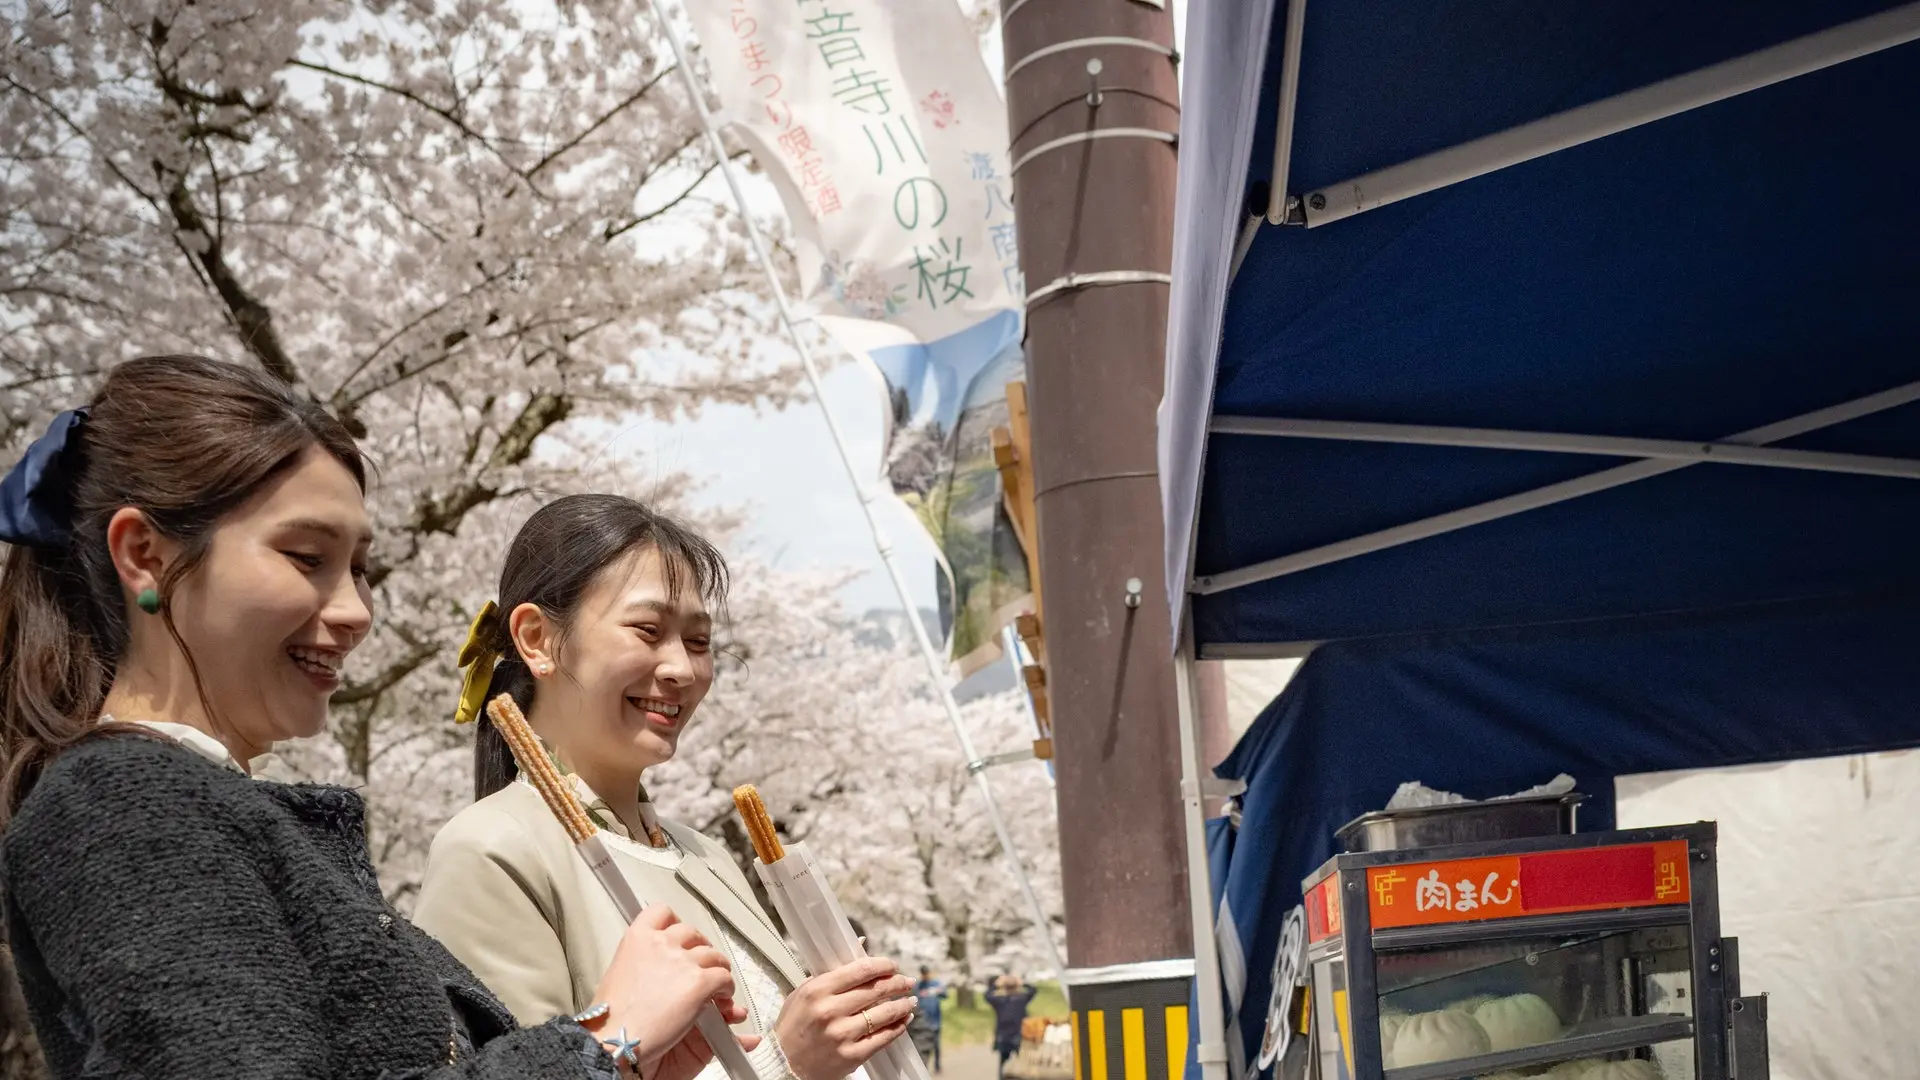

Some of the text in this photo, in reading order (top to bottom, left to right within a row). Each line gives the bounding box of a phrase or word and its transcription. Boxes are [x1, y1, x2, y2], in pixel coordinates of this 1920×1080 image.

[731, 0, 842, 223] らまつり限定酒
[797, 0, 976, 310] 音寺川の桜
